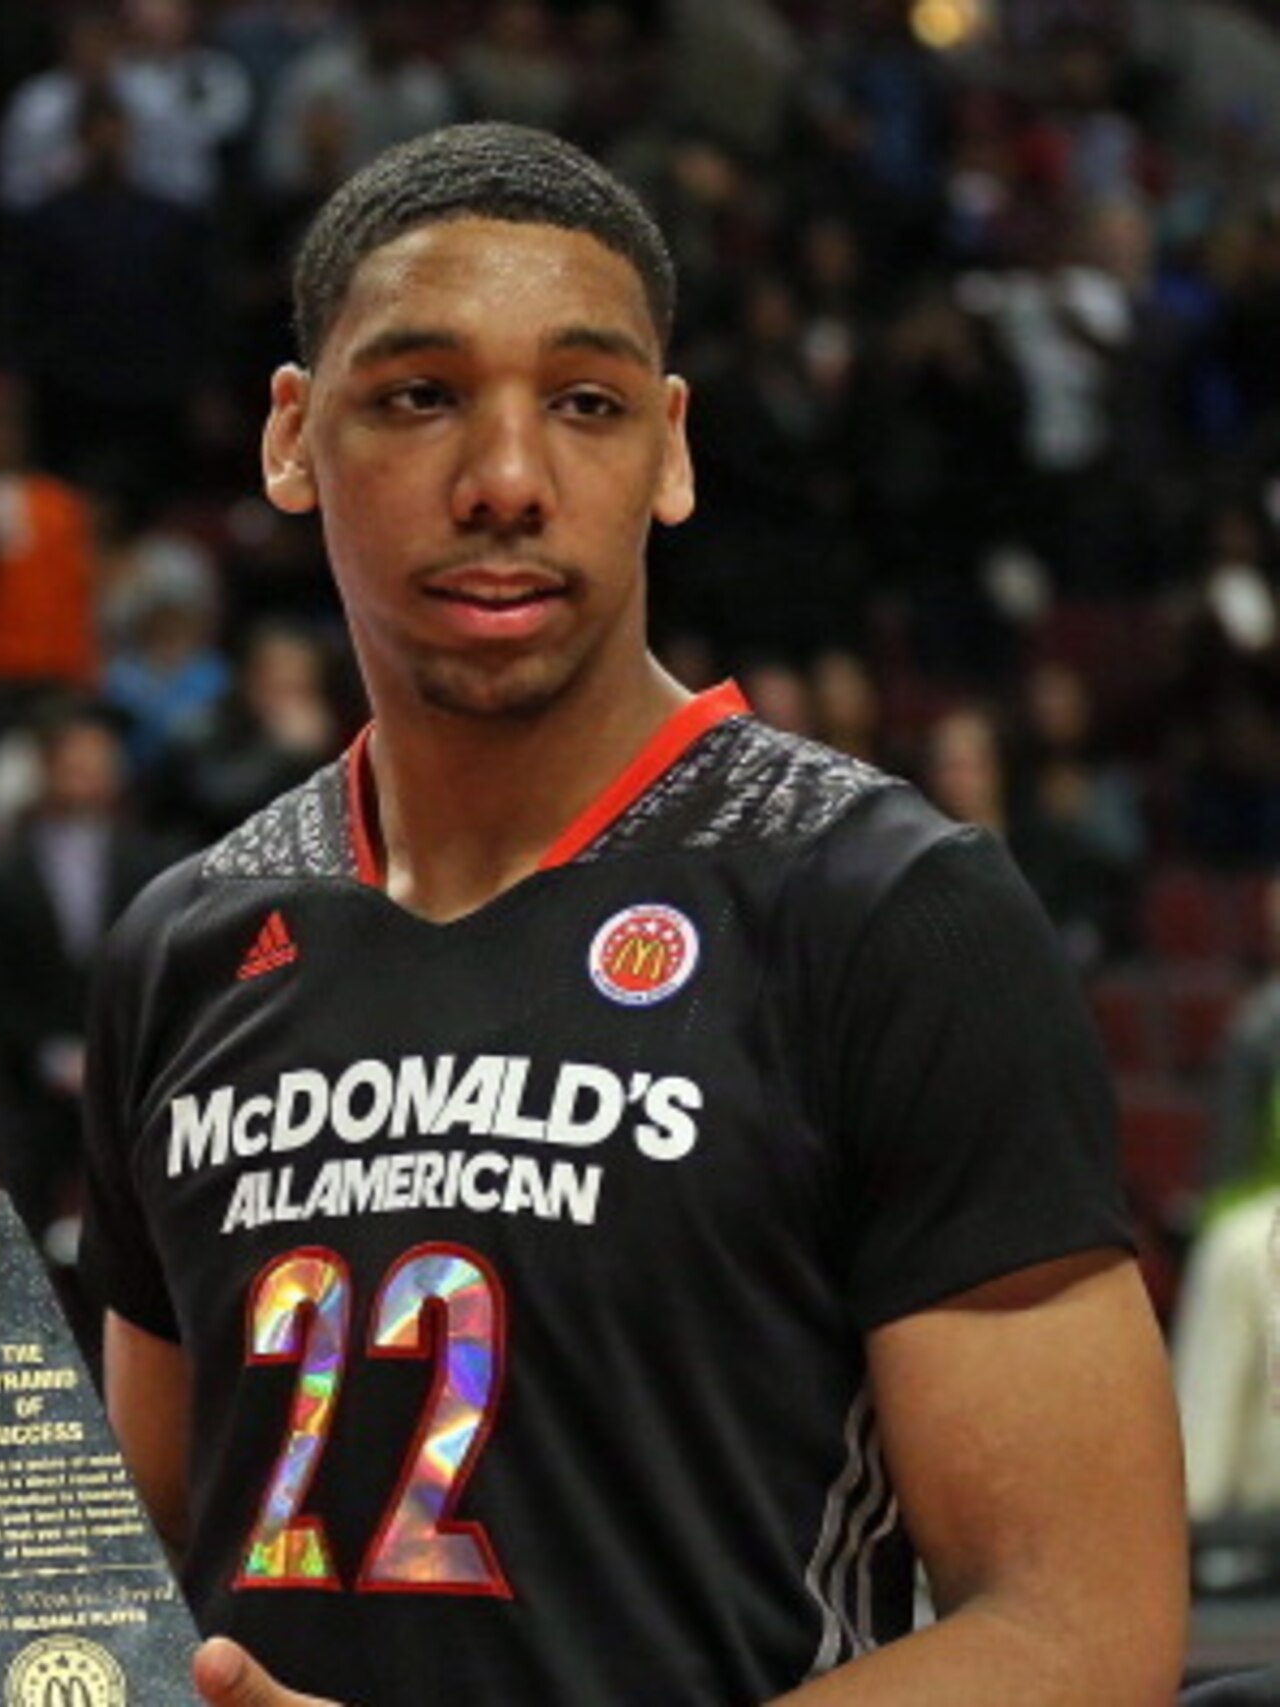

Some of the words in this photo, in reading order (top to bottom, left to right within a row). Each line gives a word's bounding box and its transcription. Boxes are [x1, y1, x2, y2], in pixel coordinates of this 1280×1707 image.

[166, 1054, 703, 1161] McDONALD'S
[0, 1343, 44, 1364] THE
[15, 1396, 44, 1418] OF
[233, 1240, 513, 1599] 22
